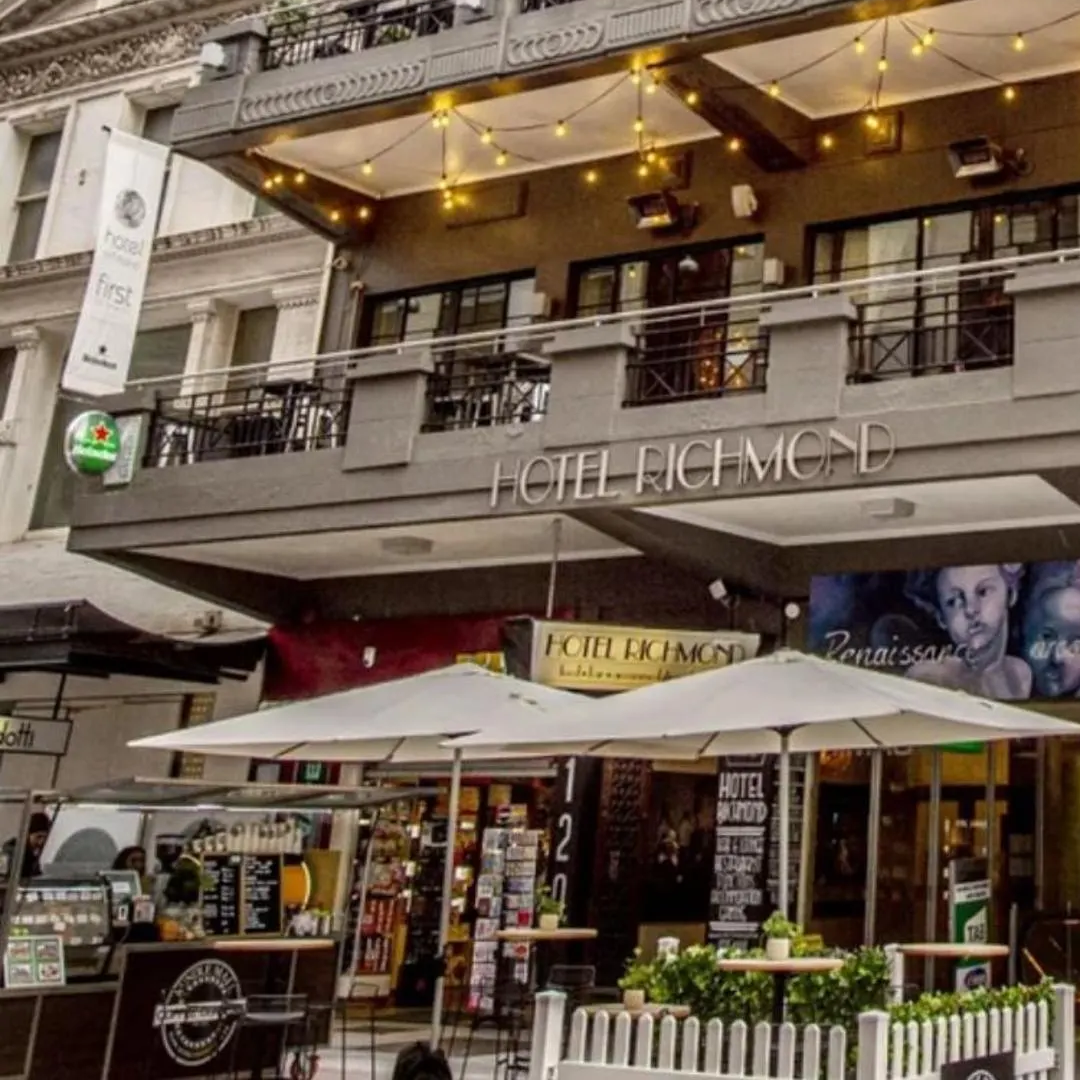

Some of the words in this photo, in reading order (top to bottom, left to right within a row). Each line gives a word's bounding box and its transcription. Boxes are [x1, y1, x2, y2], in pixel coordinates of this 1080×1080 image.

[490, 450, 621, 507] HOTEL
[635, 422, 896, 495] RICHMOND
[545, 633, 616, 660] HOTEL
[719, 772, 764, 798] HOTEL
